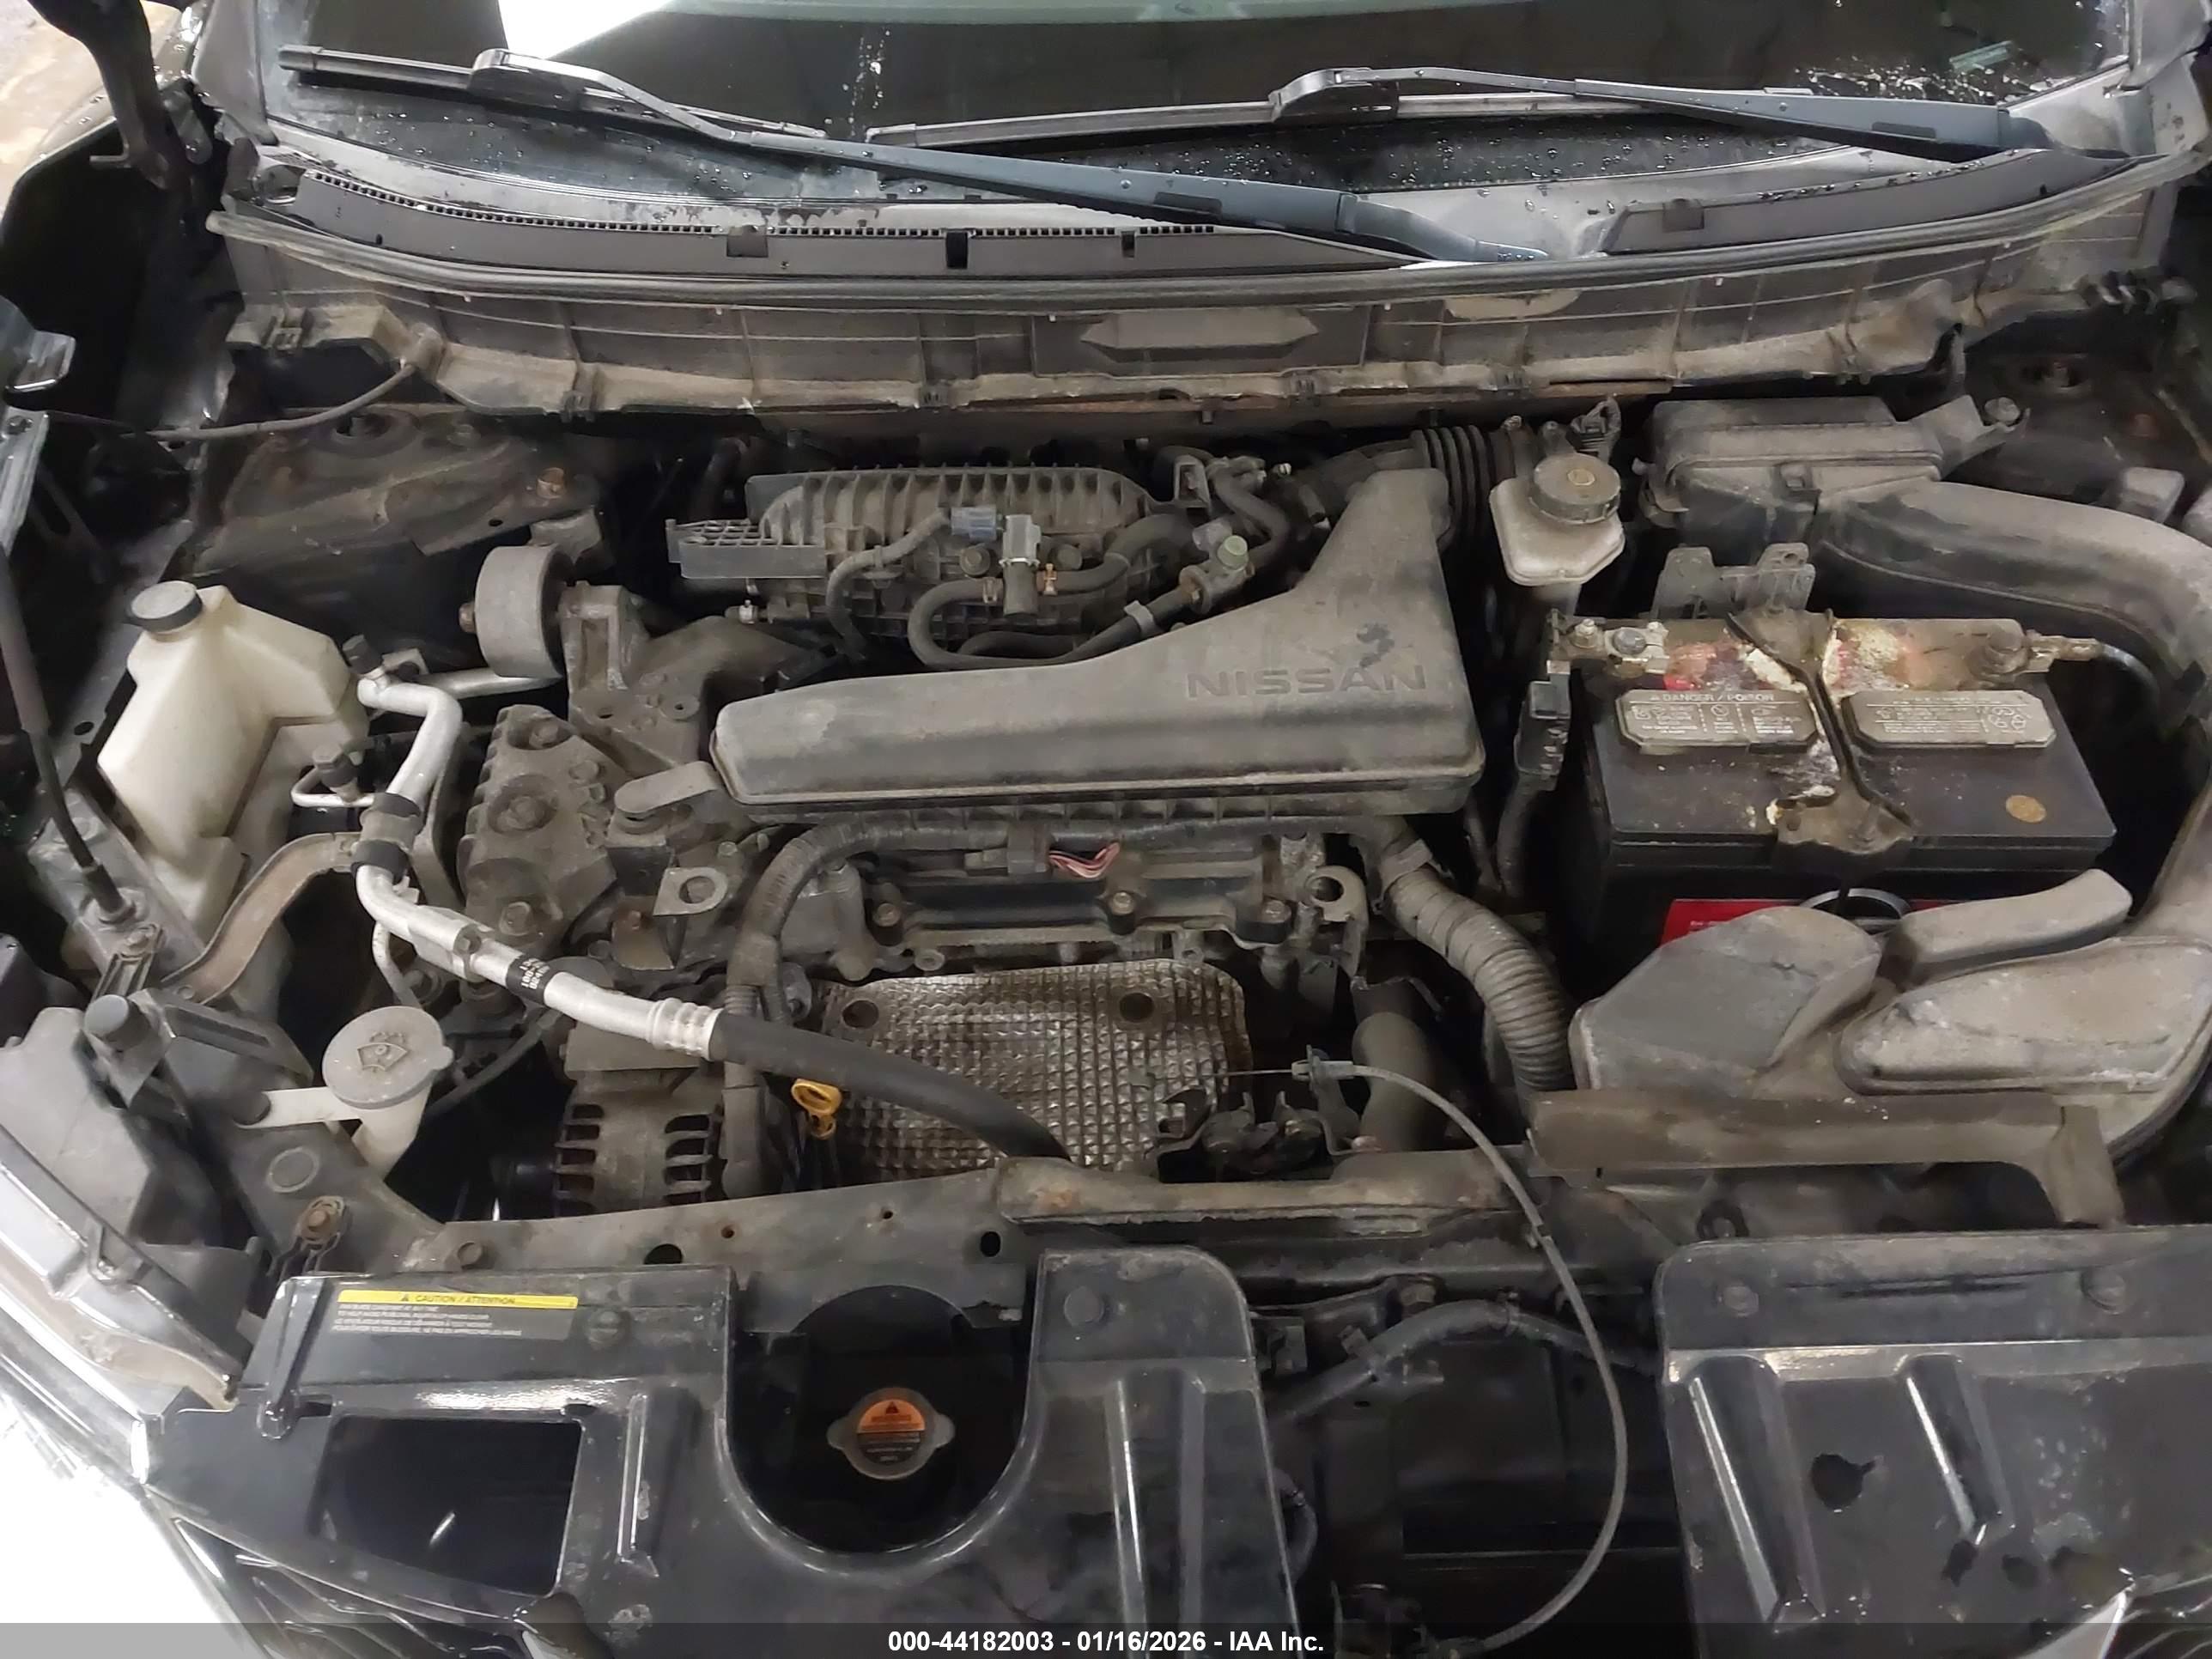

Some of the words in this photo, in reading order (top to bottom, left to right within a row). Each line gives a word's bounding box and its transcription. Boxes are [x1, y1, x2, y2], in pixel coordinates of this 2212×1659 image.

[1187, 665, 1426, 698] NISSAN
[1662, 693, 1715, 702] DANGER
[415, 1294, 456, 1304] CAUTION
[464, 1295, 515, 1305] ATTENTION
